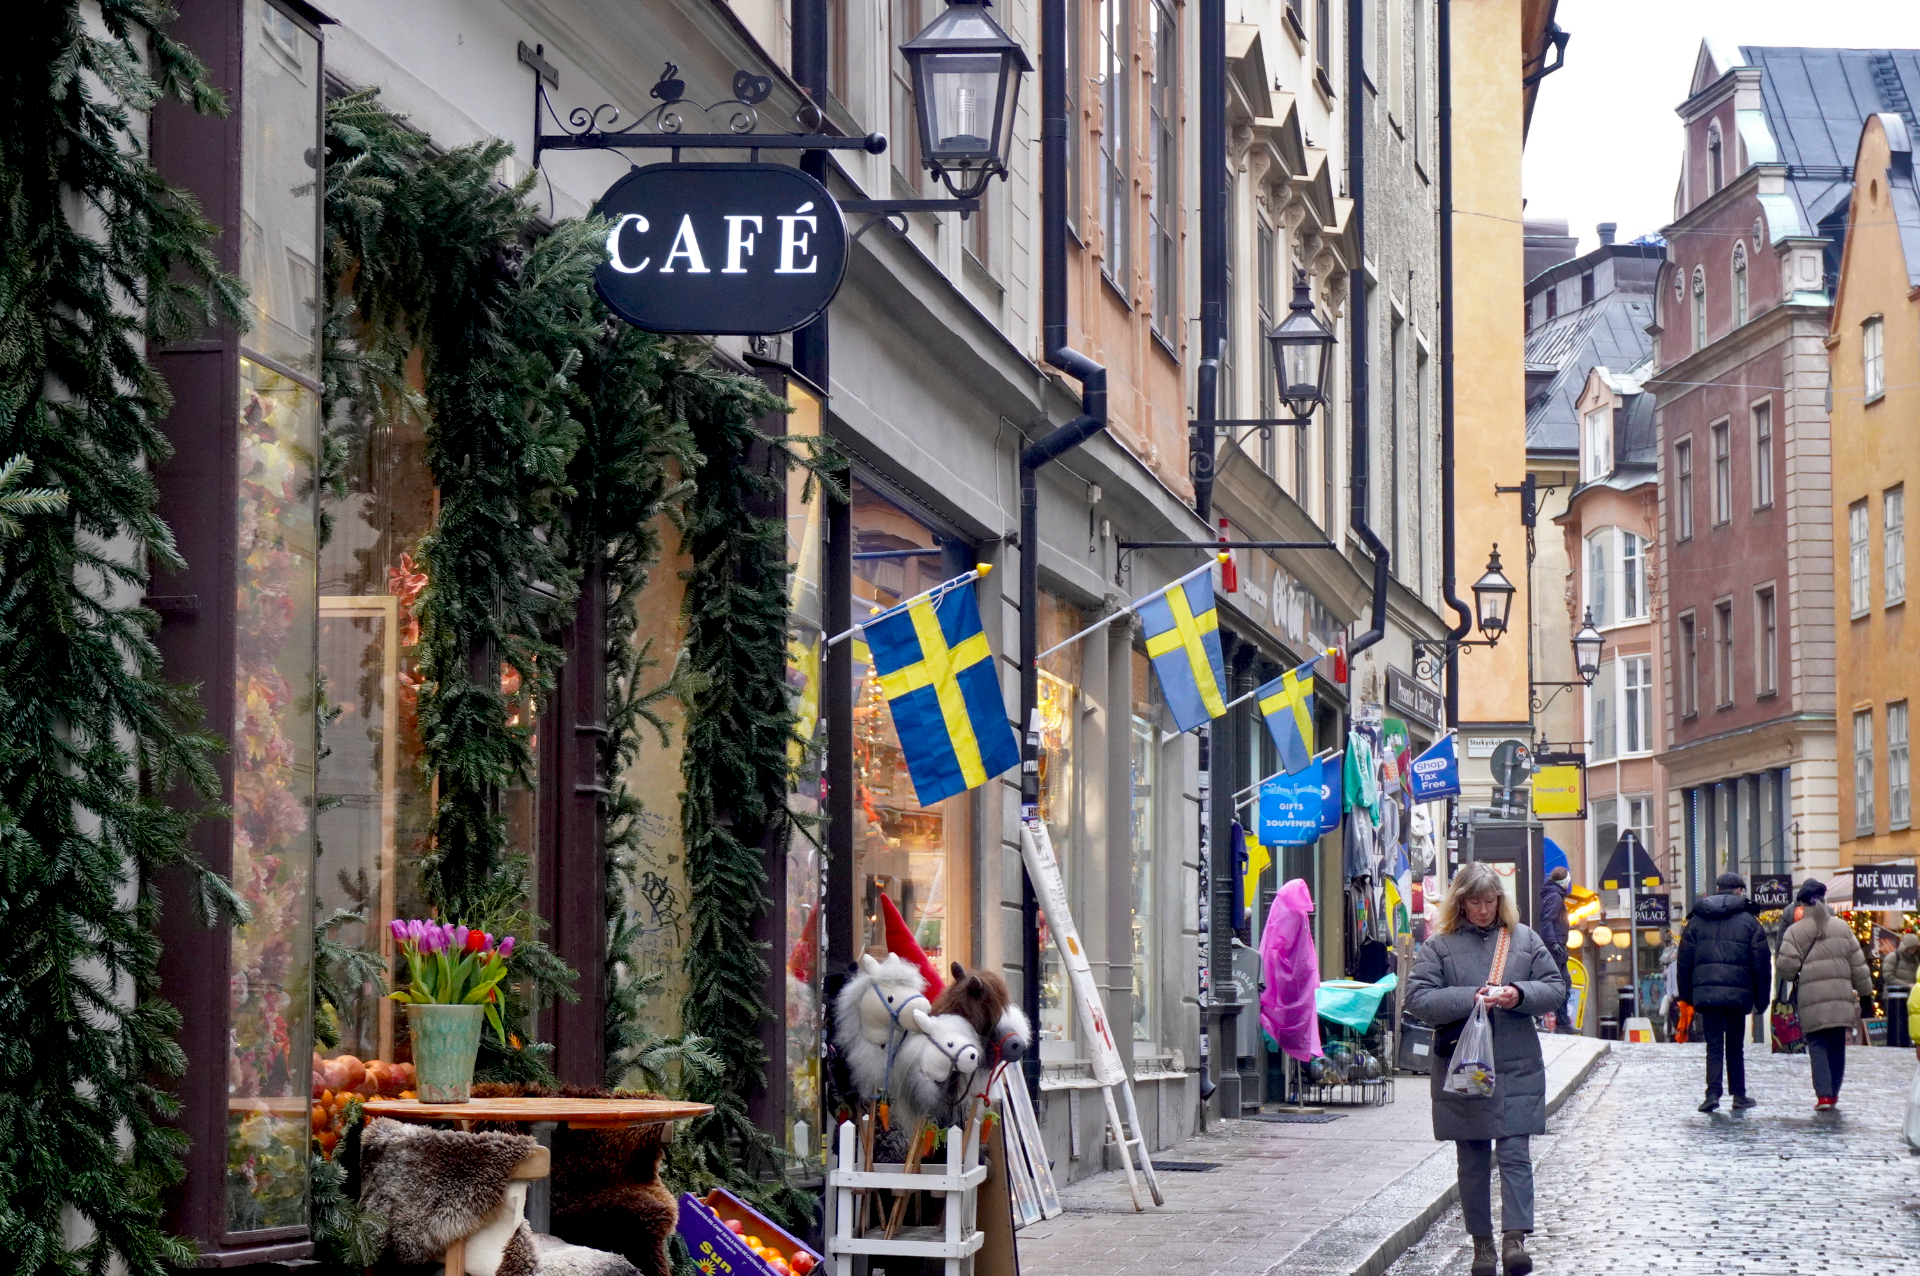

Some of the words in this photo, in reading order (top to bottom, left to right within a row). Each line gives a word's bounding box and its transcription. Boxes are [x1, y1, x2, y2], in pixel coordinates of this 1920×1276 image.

[606, 201, 817, 274] CAFÉ
[1469, 739, 1502, 747] Storkyrkob
[1416, 760, 1444, 771] Shop
[1418, 773, 1437, 781] Tax
[1422, 781, 1446, 790] Free
[1279, 802, 1304, 811] GIFTS
[1287, 811, 1294, 819] &
[1266, 819, 1316, 828] SOUVENIRS
[1856, 870, 1879, 888] CAFÉ
[1882, 873, 1915, 888] VALVET
[1754, 893, 1788, 903] PALACE
[1635, 911, 1666, 920] PALACE
[699, 1241, 732, 1273] Sun
